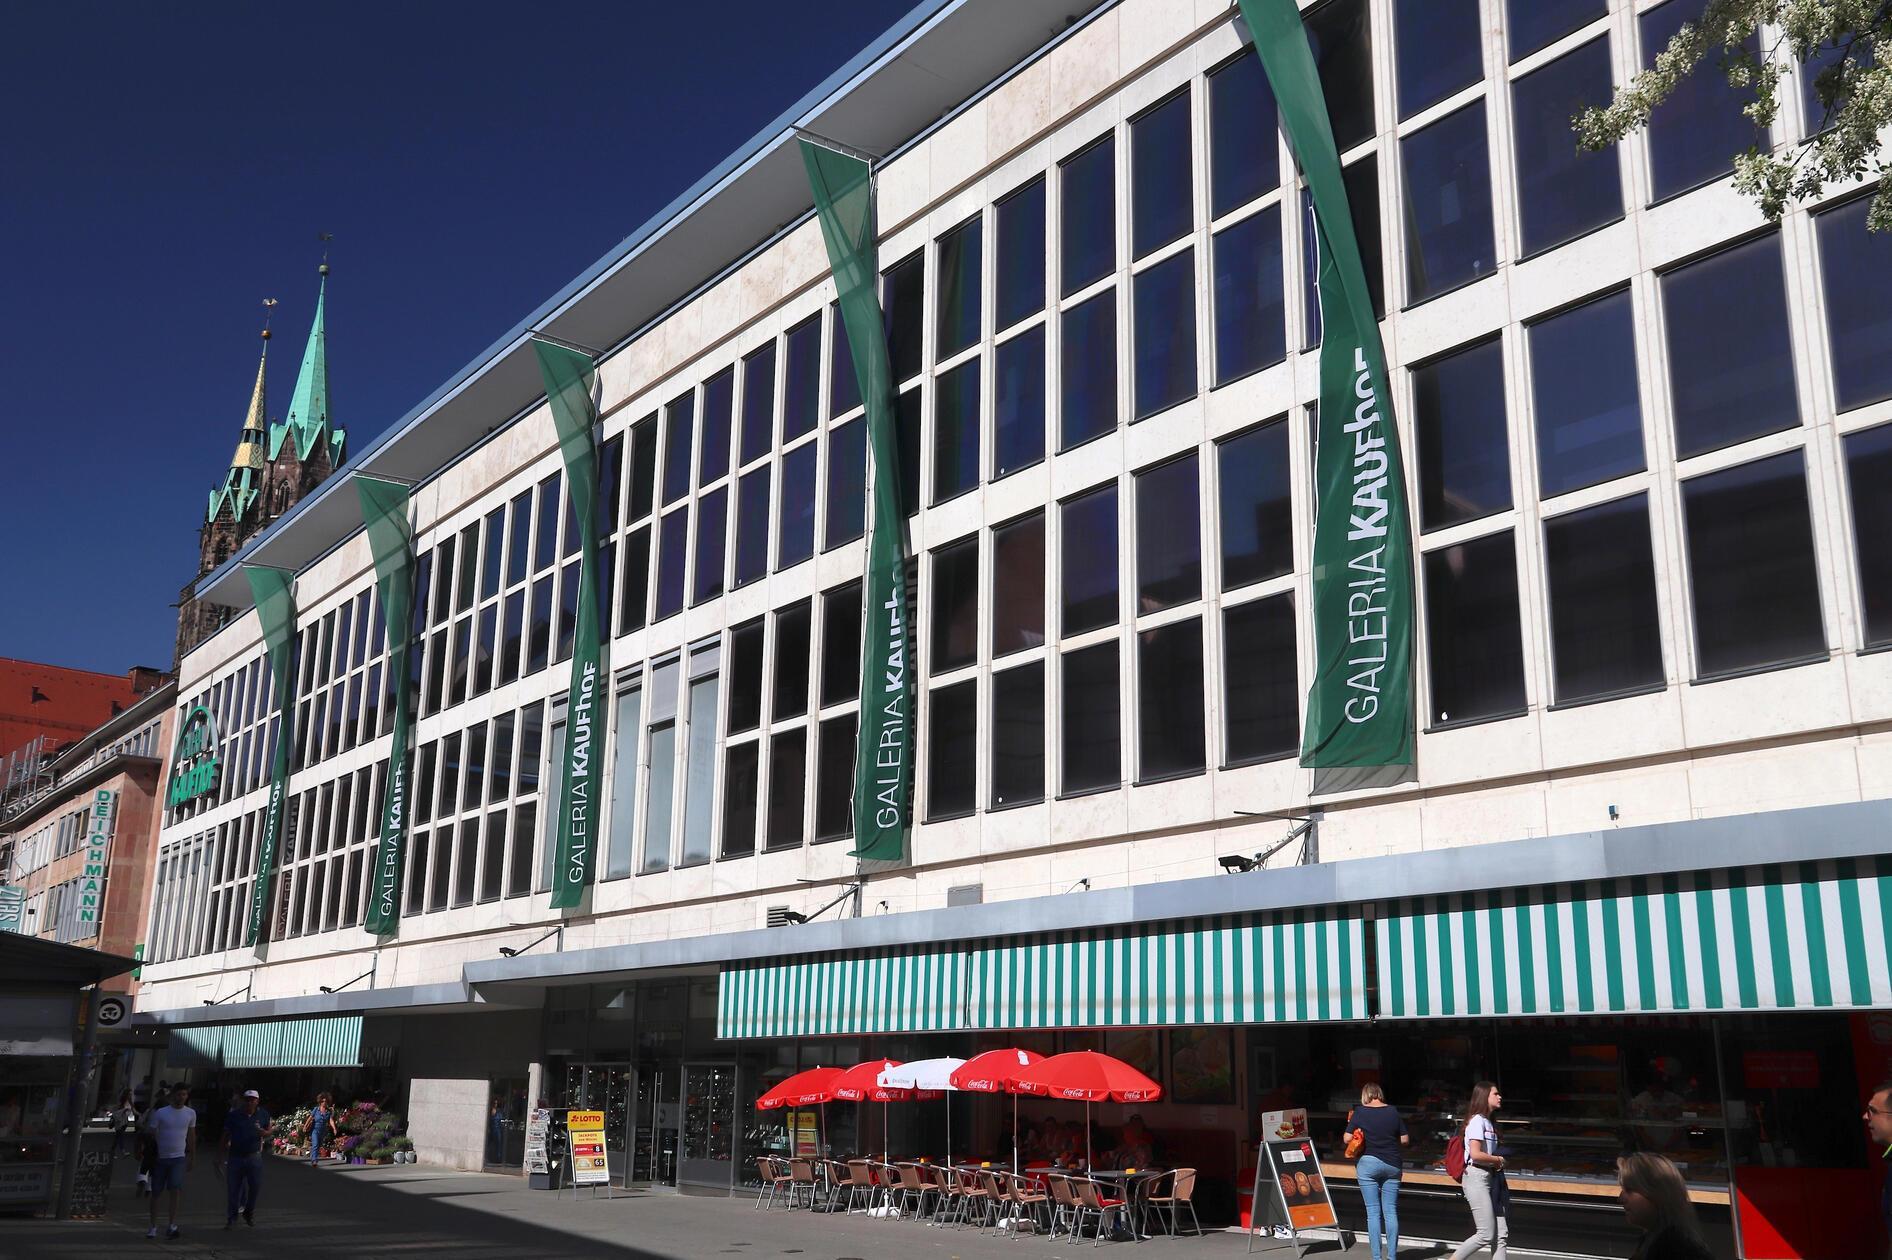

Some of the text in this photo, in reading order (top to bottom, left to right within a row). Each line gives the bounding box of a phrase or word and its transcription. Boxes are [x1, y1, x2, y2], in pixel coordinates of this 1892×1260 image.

[1345, 544, 1388, 724] GALERIA
[877, 694, 903, 829] GALERIA
[80, 790, 111, 922] DEICHMANN
[381, 833, 400, 916] GALERIA
[569, 780, 588, 883] GALERIA
